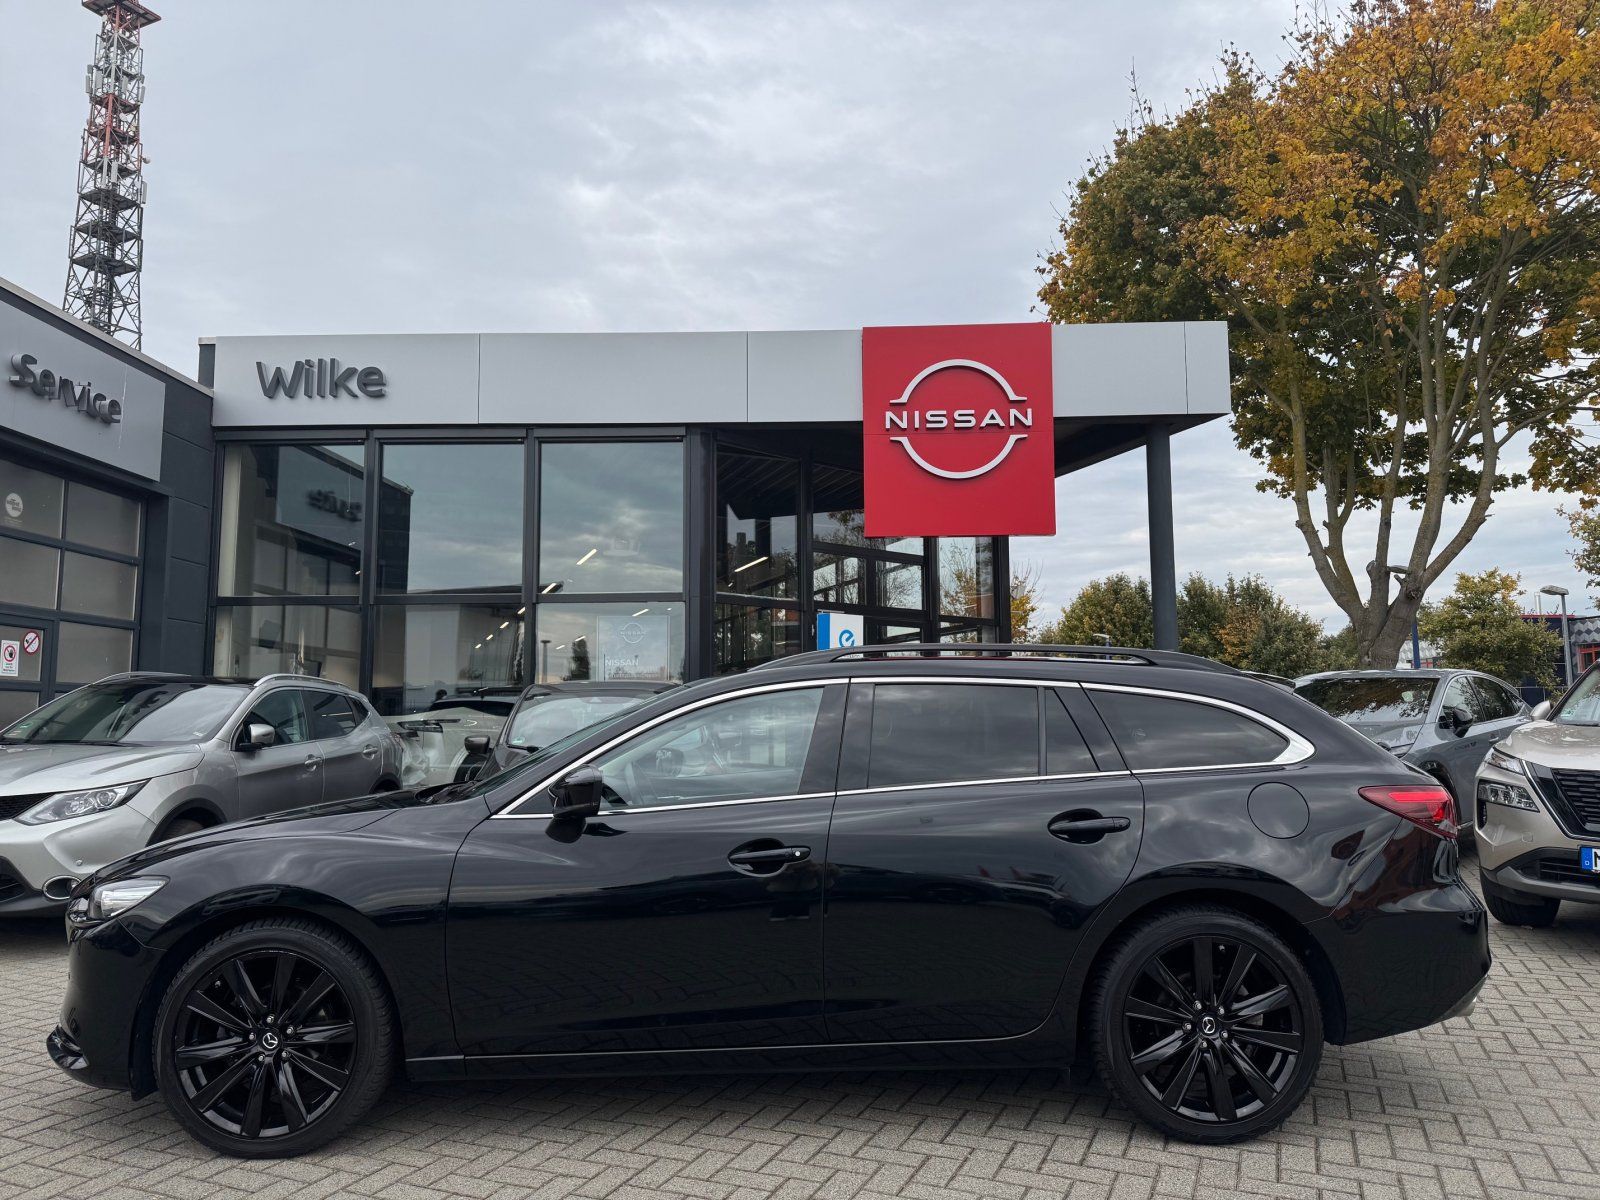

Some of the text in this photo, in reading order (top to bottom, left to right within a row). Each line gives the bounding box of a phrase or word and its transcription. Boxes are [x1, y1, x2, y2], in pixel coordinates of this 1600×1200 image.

[9, 354, 121, 423] Service
[256, 358, 386, 399] Wilke
[885, 408, 1033, 430] NISSAN
